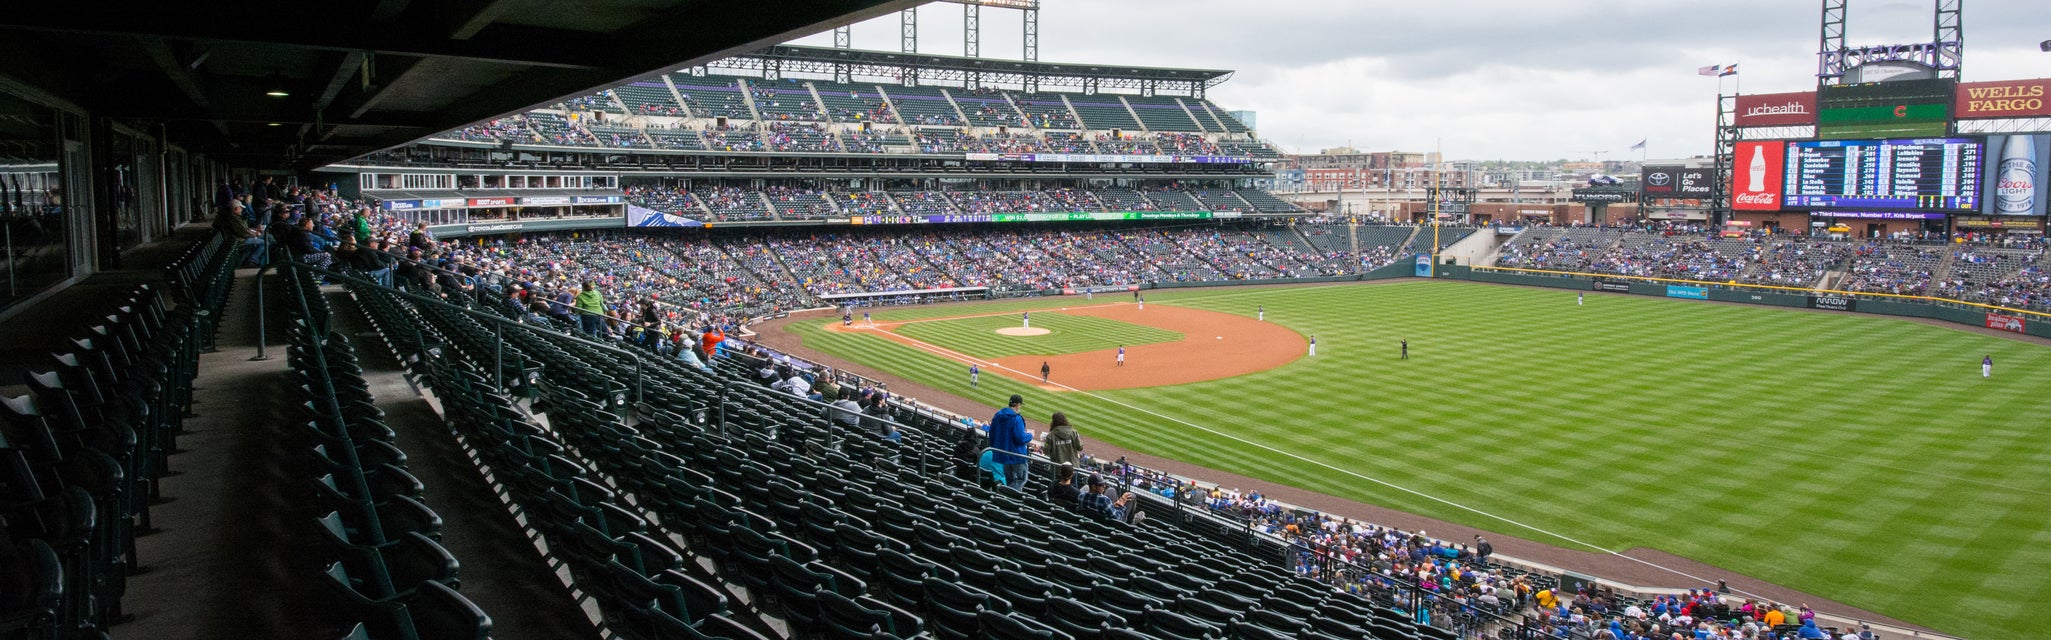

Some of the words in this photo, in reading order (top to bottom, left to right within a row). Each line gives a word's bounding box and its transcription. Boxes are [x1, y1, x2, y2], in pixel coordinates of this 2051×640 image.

[1816, 41, 1961, 77] ROCKIES
[1968, 85, 2044, 100] WELLS
[1748, 101, 1804, 116] uchealth
[1968, 98, 2043, 112] FARGO
[1998, 178, 2032, 188] Coors
[1736, 192, 1776, 204] Coca-Cola
[1988, 314, 2008, 322] brakes
